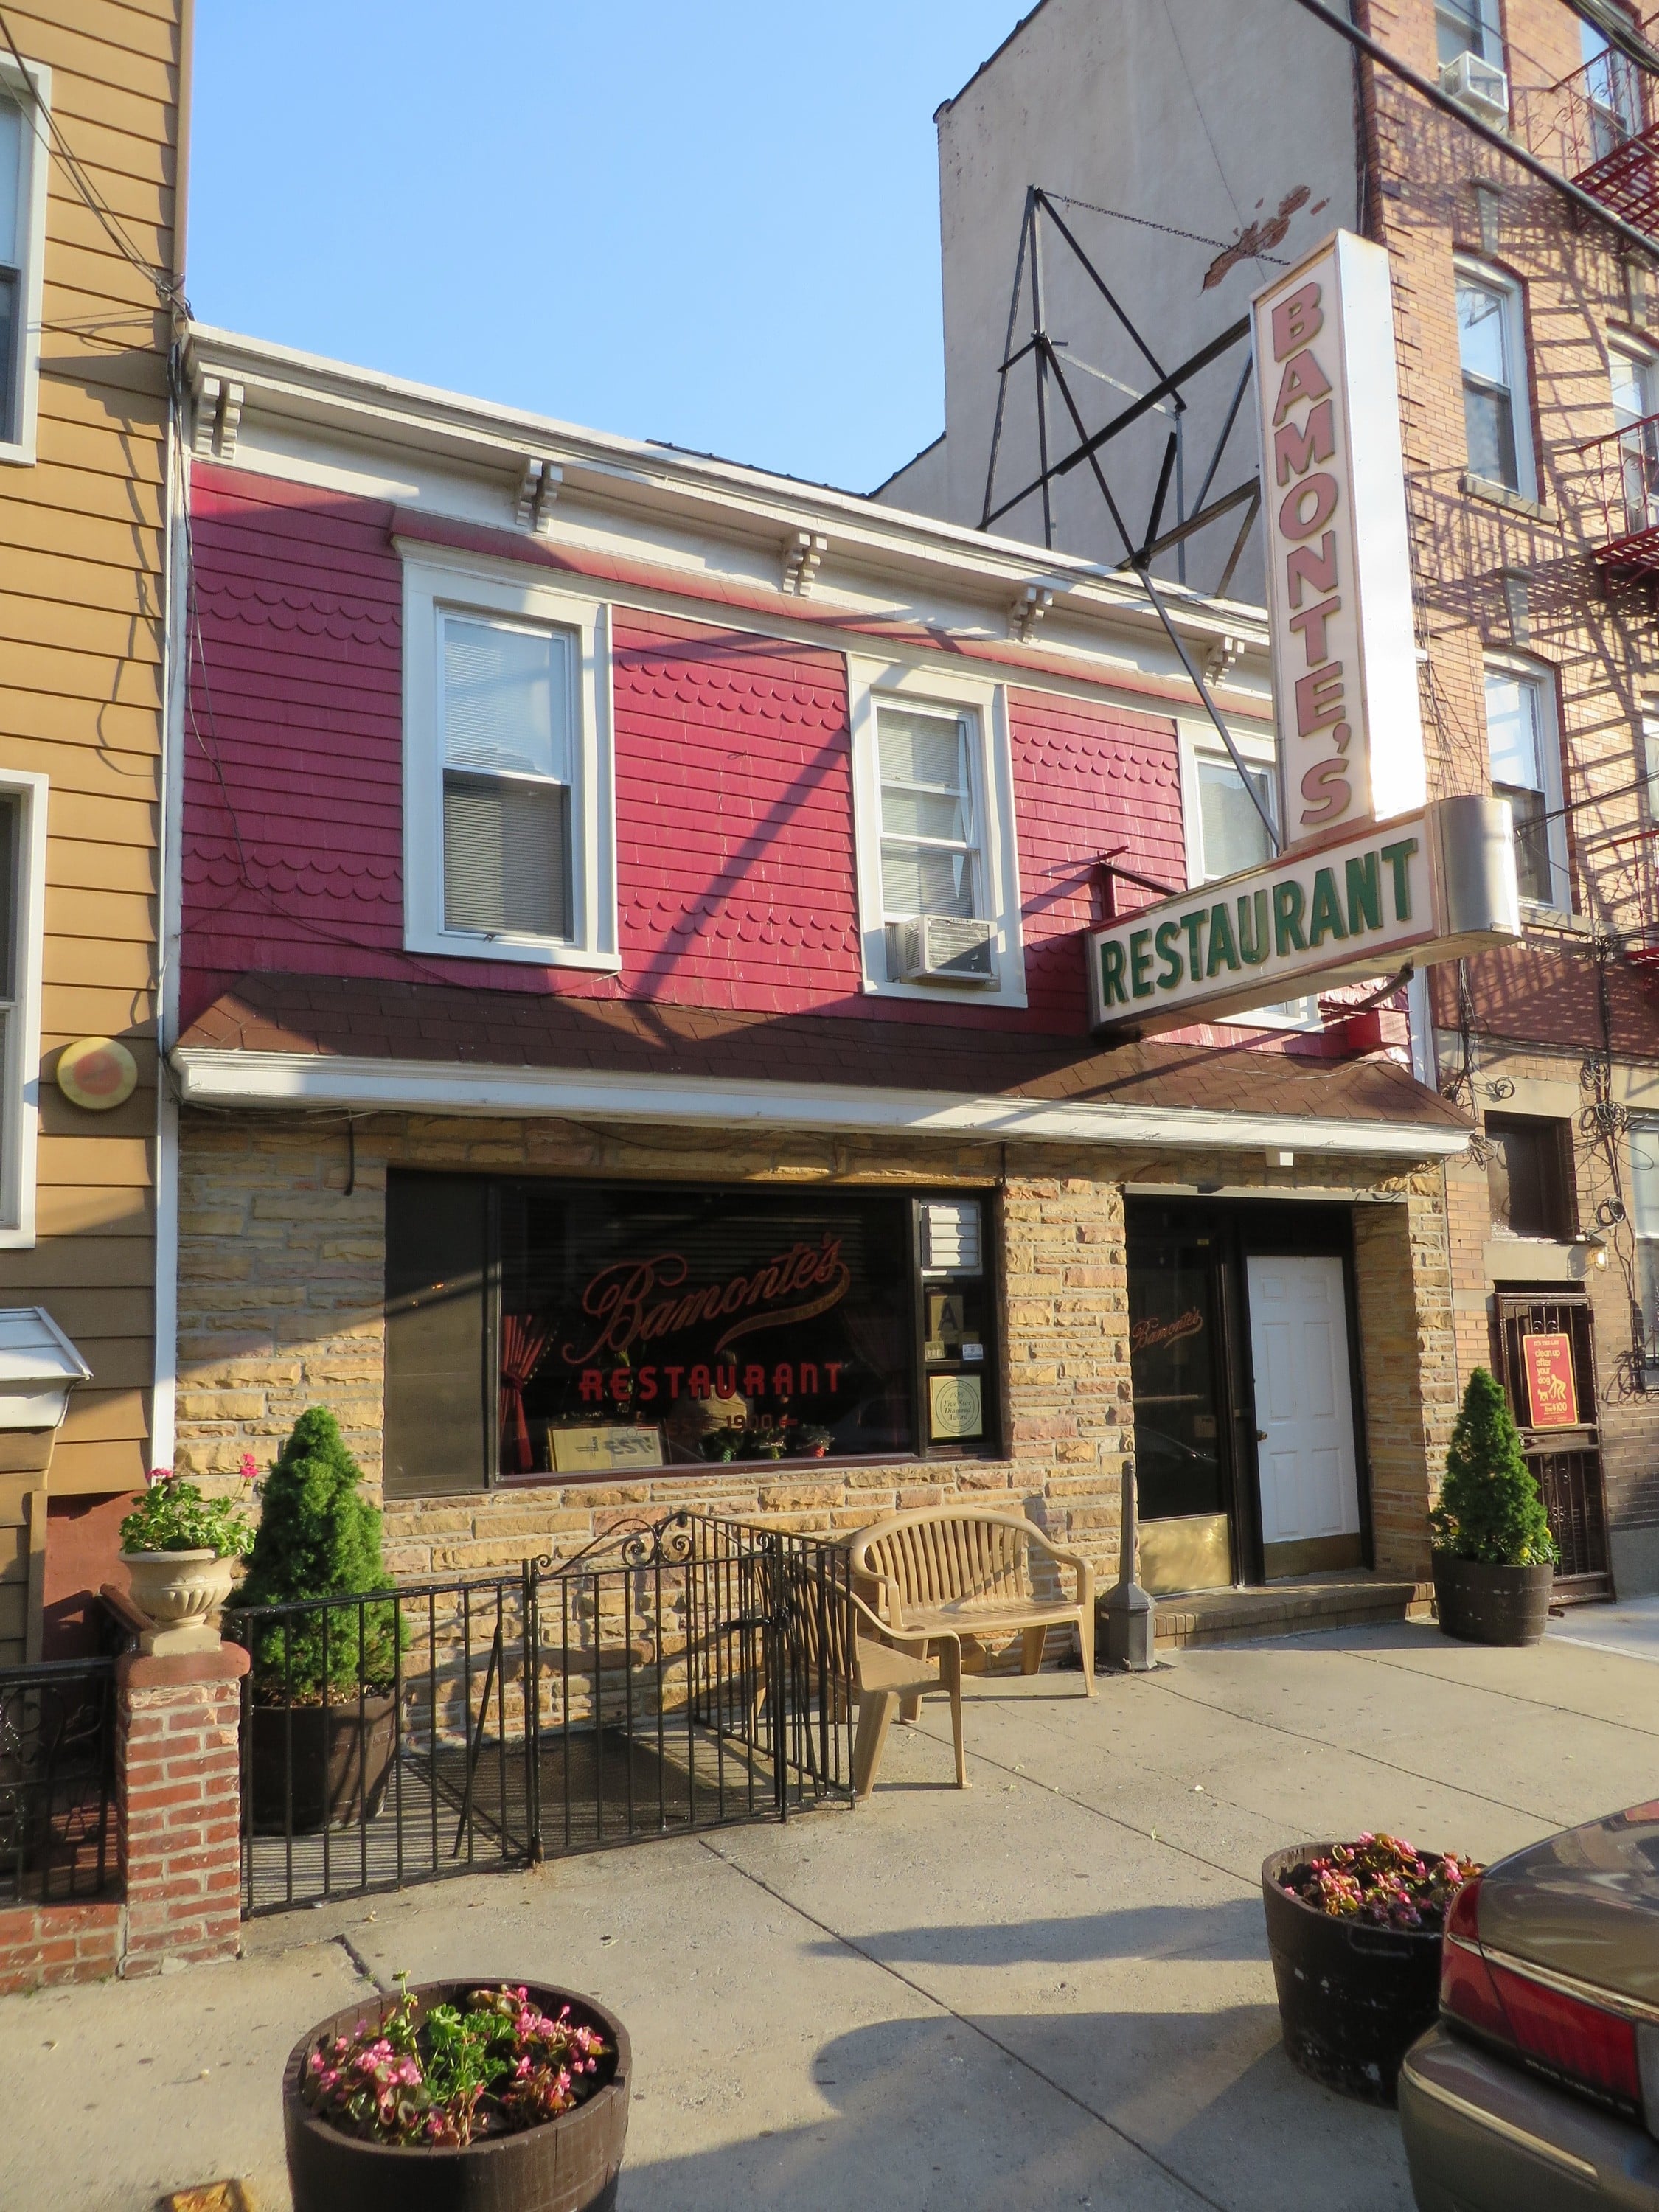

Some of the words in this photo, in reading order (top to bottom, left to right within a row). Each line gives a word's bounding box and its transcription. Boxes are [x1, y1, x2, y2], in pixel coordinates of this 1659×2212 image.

[1272, 281, 1352, 826] BAMONTE'S
[1100, 837, 1419, 1007] RESTAURANT
[563, 1231, 850, 1364] Bamonte's
[937, 1301, 958, 1332] A
[1535, 1349, 1552, 1357] clean
[1552, 1349, 1561, 1359] up
[1536, 1358, 1551, 1366] after
[1537, 1368, 1551, 1376] your
[1538, 1377, 1551, 1385] dog
[579, 1362, 843, 1402] RESTAURANT
[1552, 1402, 1568, 1411] $100
[725, 1413, 773, 1431] 1900
